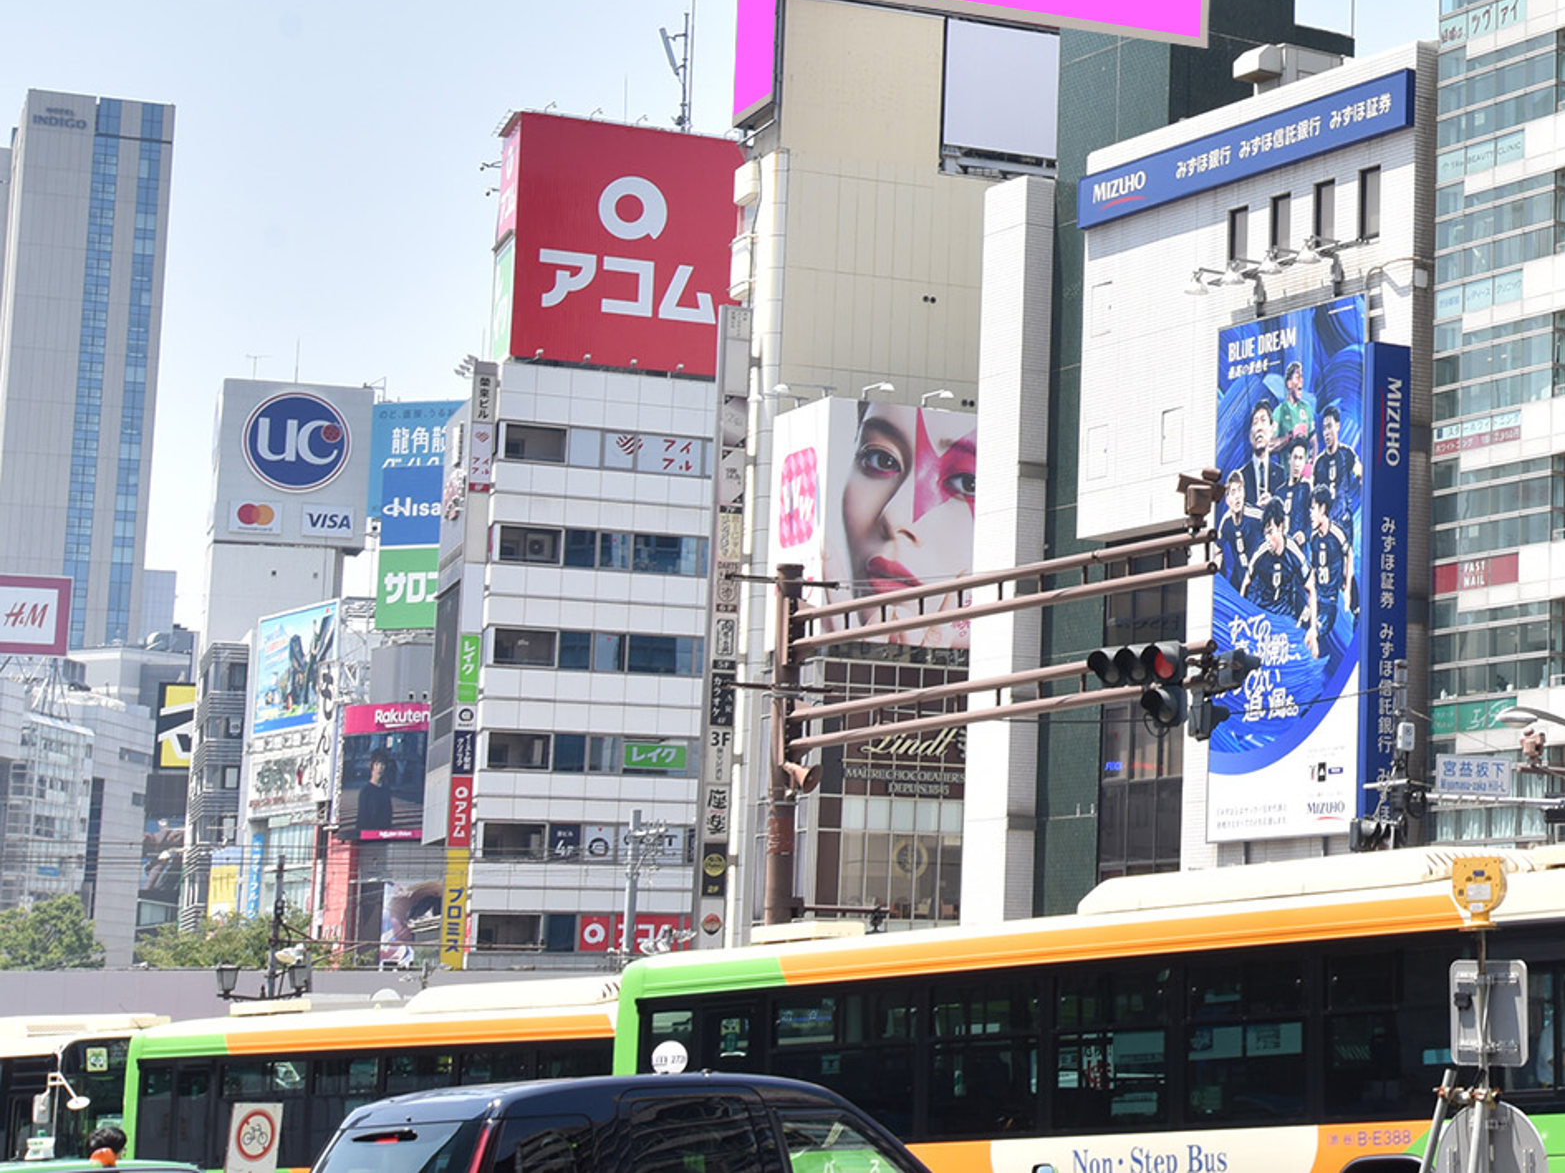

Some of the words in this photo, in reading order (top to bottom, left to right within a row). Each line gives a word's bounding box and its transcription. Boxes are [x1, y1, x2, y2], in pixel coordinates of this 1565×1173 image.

[33, 113, 87, 130] INDIGO
[1092, 171, 1146, 204] MIZUHO
[1175, 148, 1232, 180] みずほ銀行
[1238, 116, 1321, 159] みずほ信託銀行
[1329, 92, 1392, 129] みずほ証券
[538, 247, 717, 325] アコム
[1228, 336, 1256, 363] BLUE
[1257, 326, 1297, 356] DREAM
[1385, 376, 1403, 467] MIZUHO
[306, 511, 352, 531] VISA
[1379, 515, 1397, 609] みずほ証券
[1463, 560, 1487, 574] FAST
[1463, 573, 1486, 588] NAIL
[3, 601, 49, 629] H&M
[463, 639, 474, 675] レイク
[1376, 623, 1395, 754] みずほ信託銀行
[373, 708, 430, 724] Rakuten
[710, 731, 731, 747] 3F
[860, 720, 959, 757] Lindt
[631, 747, 677, 763] レイク
[1442, 760, 1506, 777] 宮益坂下
[455, 800, 467, 837] アコム
[1307, 800, 1346, 814] MIZUHO
[446, 887, 464, 954] プロミス
[1357, 1129, 1412, 1148] B-E388
[1187, 1144, 1228, 1172] Bus
